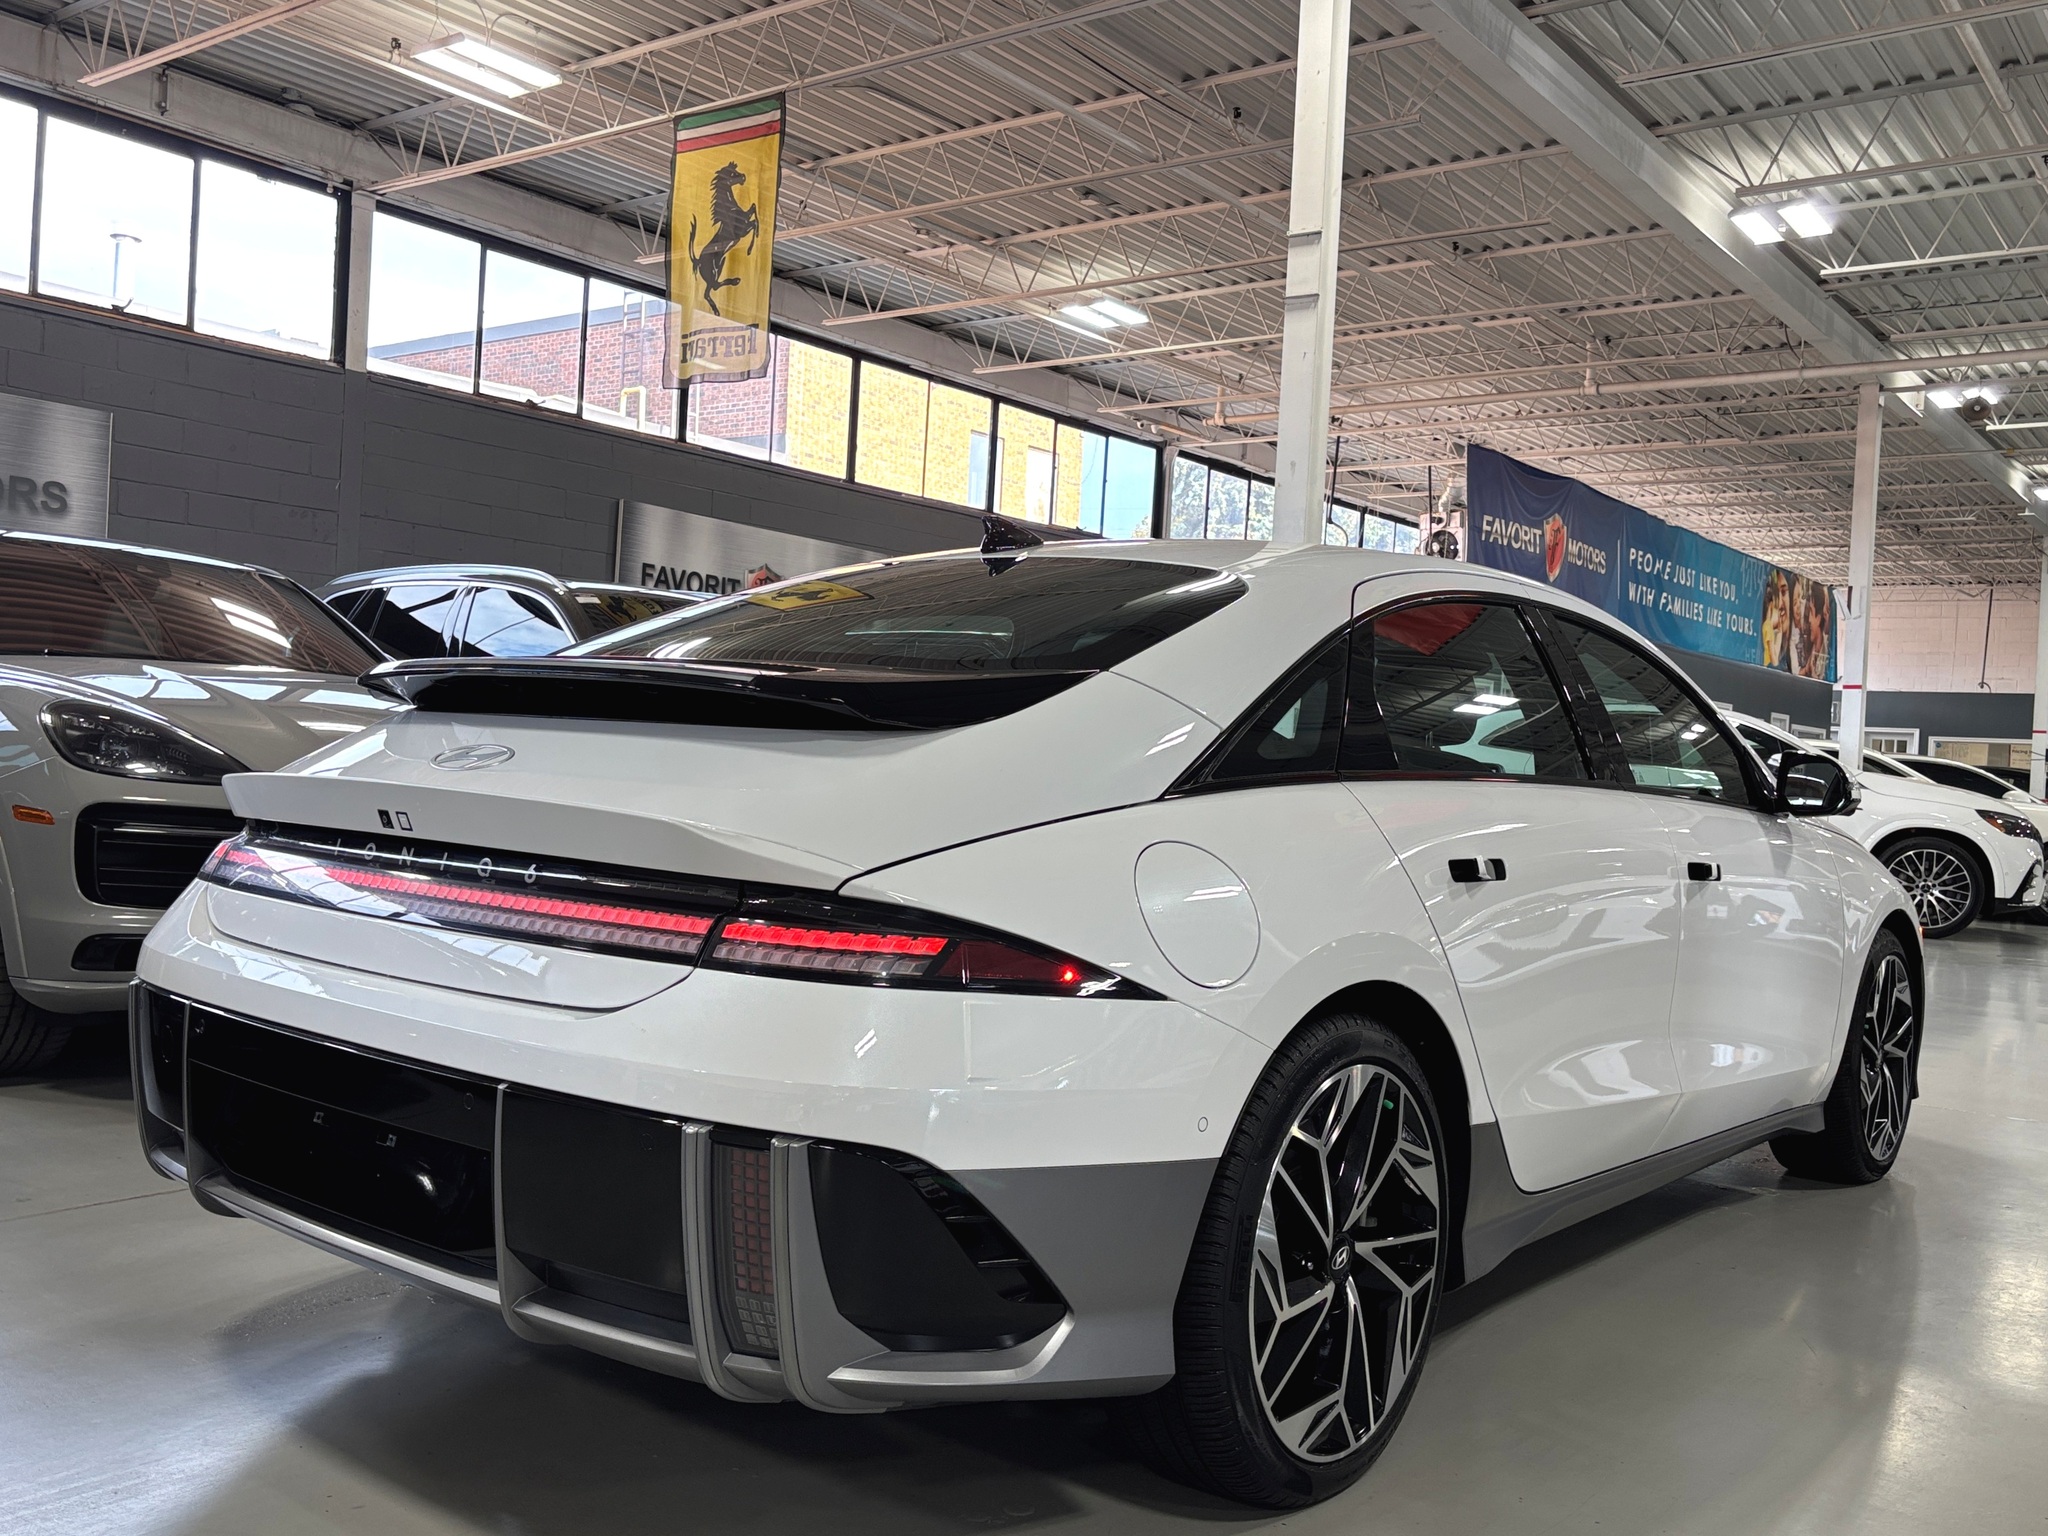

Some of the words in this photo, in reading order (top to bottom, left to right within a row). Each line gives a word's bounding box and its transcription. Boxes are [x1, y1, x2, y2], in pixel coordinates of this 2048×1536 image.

[0, 475, 69, 513] RS
[1481, 514, 1542, 554] FAVORIT
[1567, 538, 1607, 575] MOTORS
[641, 562, 740, 595] FAVORIT
[1673, 565, 1696, 588] JUST
[1699, 573, 1718, 595] LIKE
[1629, 581, 1655, 608] WITH
[1659, 592, 1704, 622] FAMILIES
[1706, 606, 1722, 628] LIKE
[1726, 612, 1757, 636] YOURS.
[334, 838, 493, 877] IONIQ
[523, 863, 537, 884] 6
